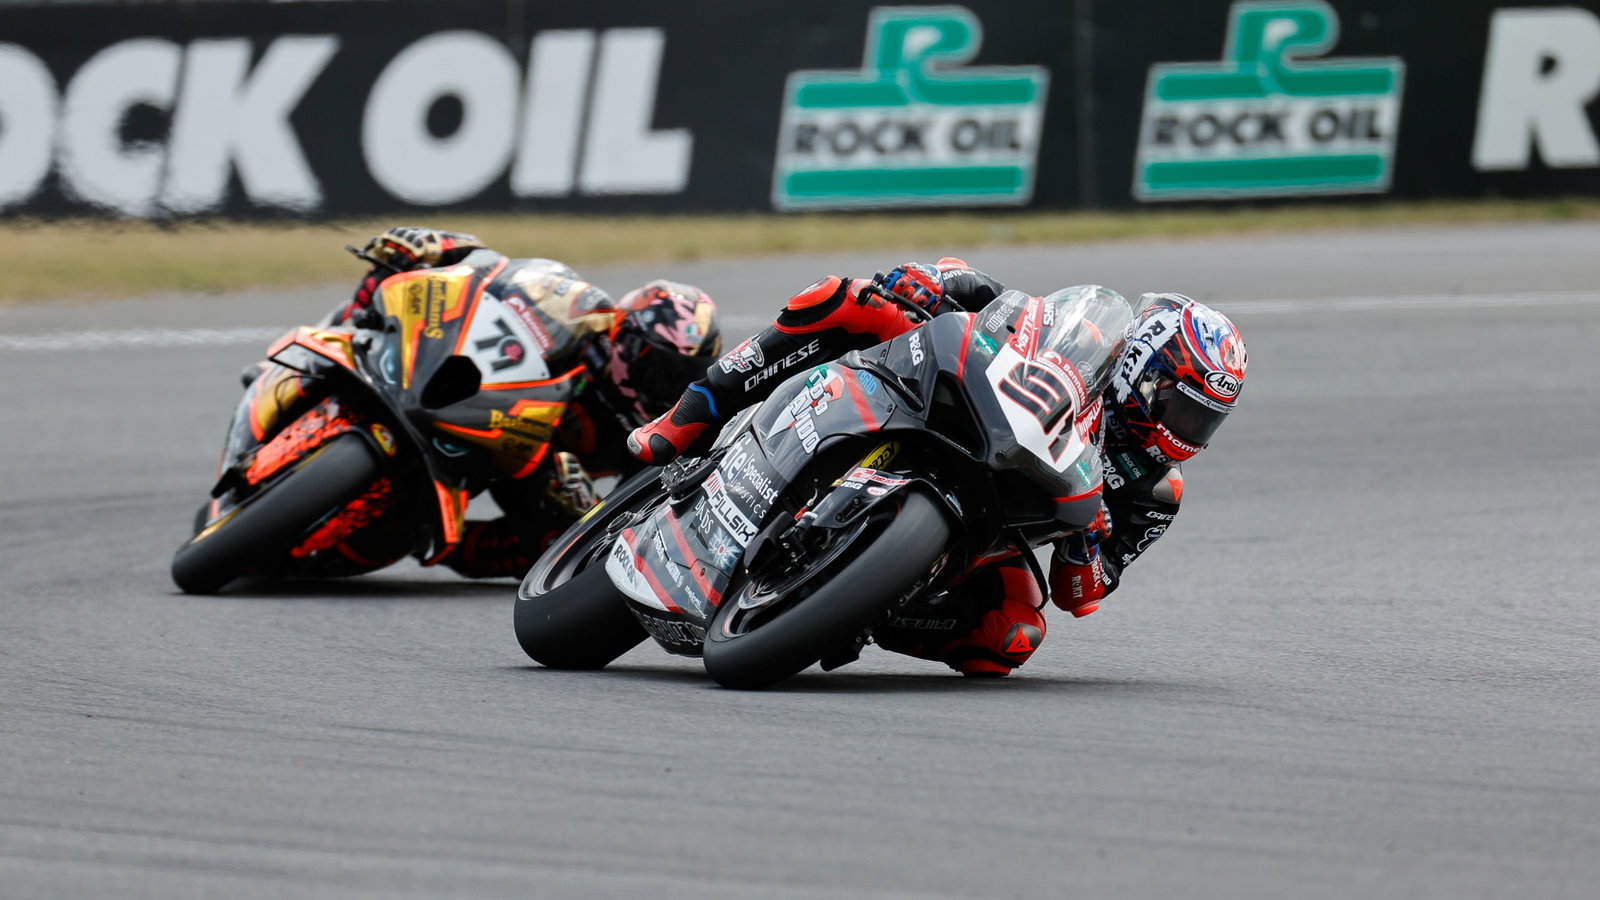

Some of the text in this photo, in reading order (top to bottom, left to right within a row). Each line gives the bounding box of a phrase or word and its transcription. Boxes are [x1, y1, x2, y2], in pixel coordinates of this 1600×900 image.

[361, 29, 693, 205] OIL
[792, 117, 1023, 155] ROCK OIL
[1153, 108, 1385, 147] ROCK OIL
[473, 317, 526, 374] 79
[744, 338, 820, 393] DAINESE
[909, 331, 925, 366] R&G
[1063, 362, 1086, 406] Bennetts
[1209, 375, 1237, 393] Arai
[743, 456, 779, 506] Specialist
